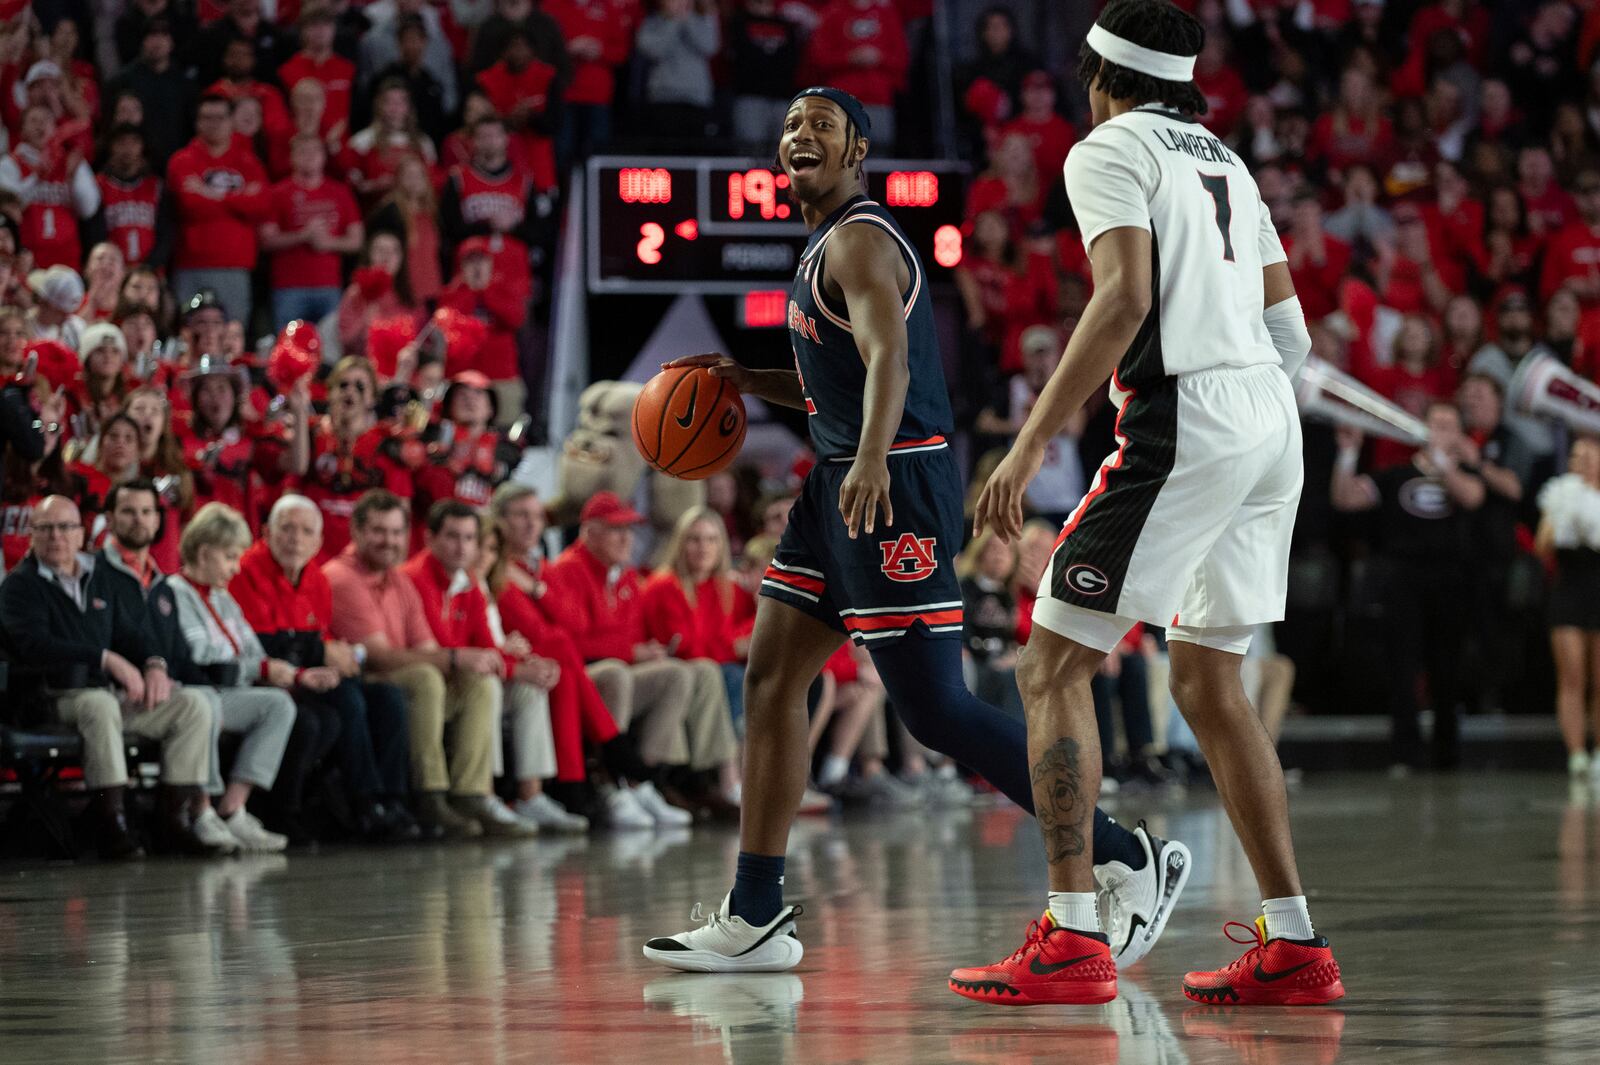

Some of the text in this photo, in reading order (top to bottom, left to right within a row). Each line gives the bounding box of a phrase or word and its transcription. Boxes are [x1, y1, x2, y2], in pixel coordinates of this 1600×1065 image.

[1196, 168, 1236, 263] 7
[637, 222, 664, 264] 2
[880, 532, 937, 582] AU
